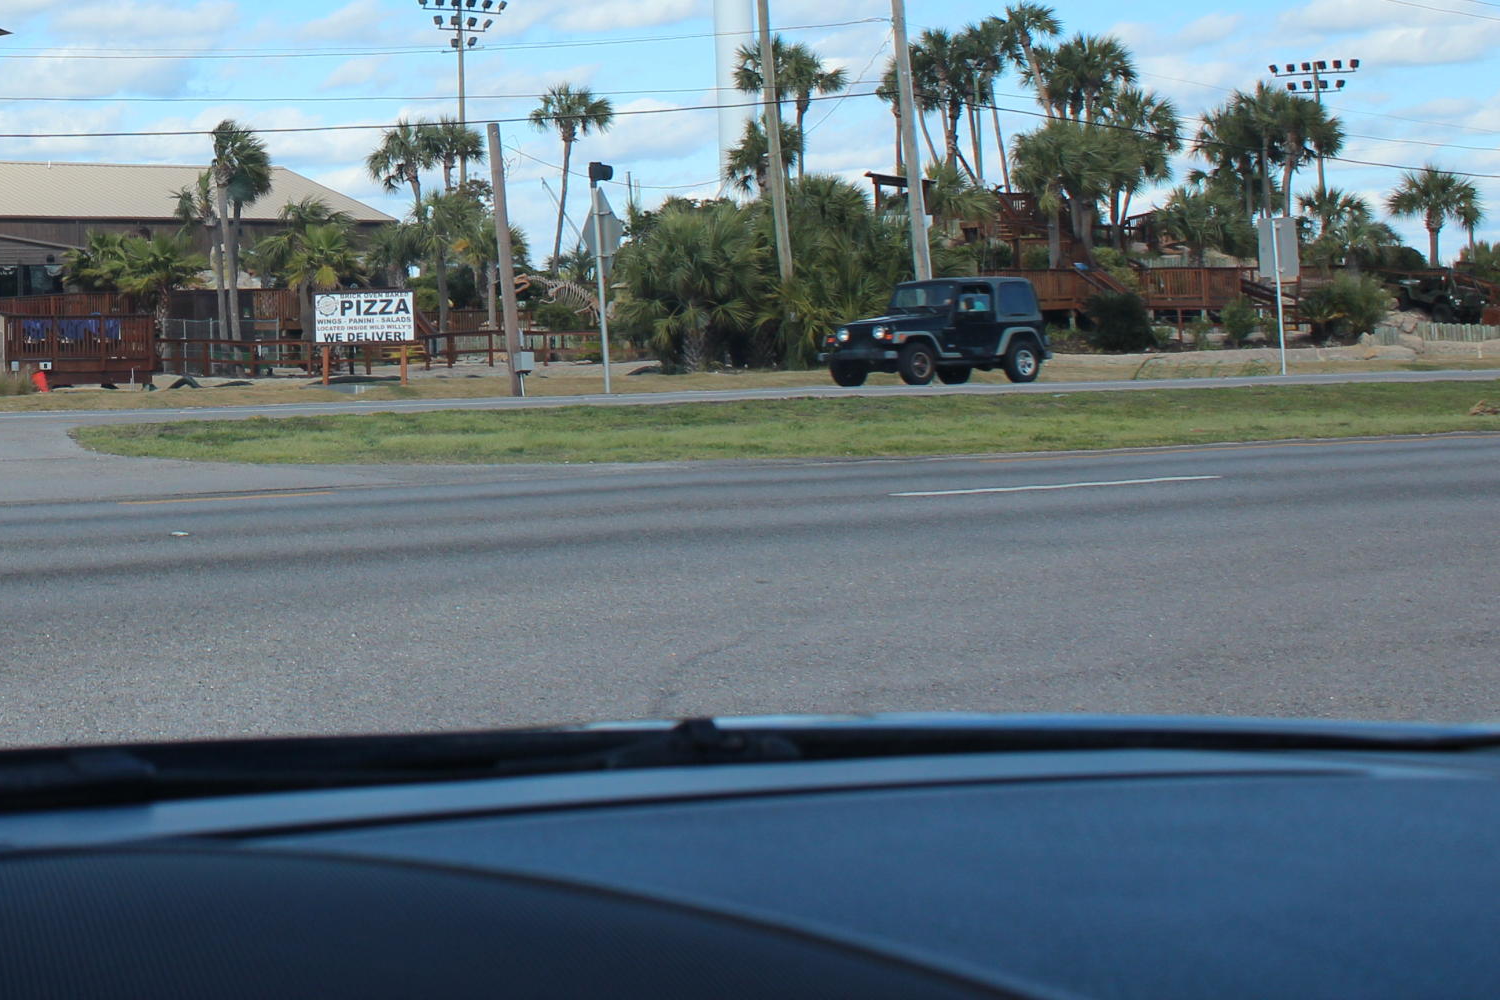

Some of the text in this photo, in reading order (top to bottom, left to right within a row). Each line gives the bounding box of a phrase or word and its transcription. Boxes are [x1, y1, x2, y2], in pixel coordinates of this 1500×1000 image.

[340, 298, 410, 316] PIZZA
[324, 332, 406, 342] WE DELIVER!
